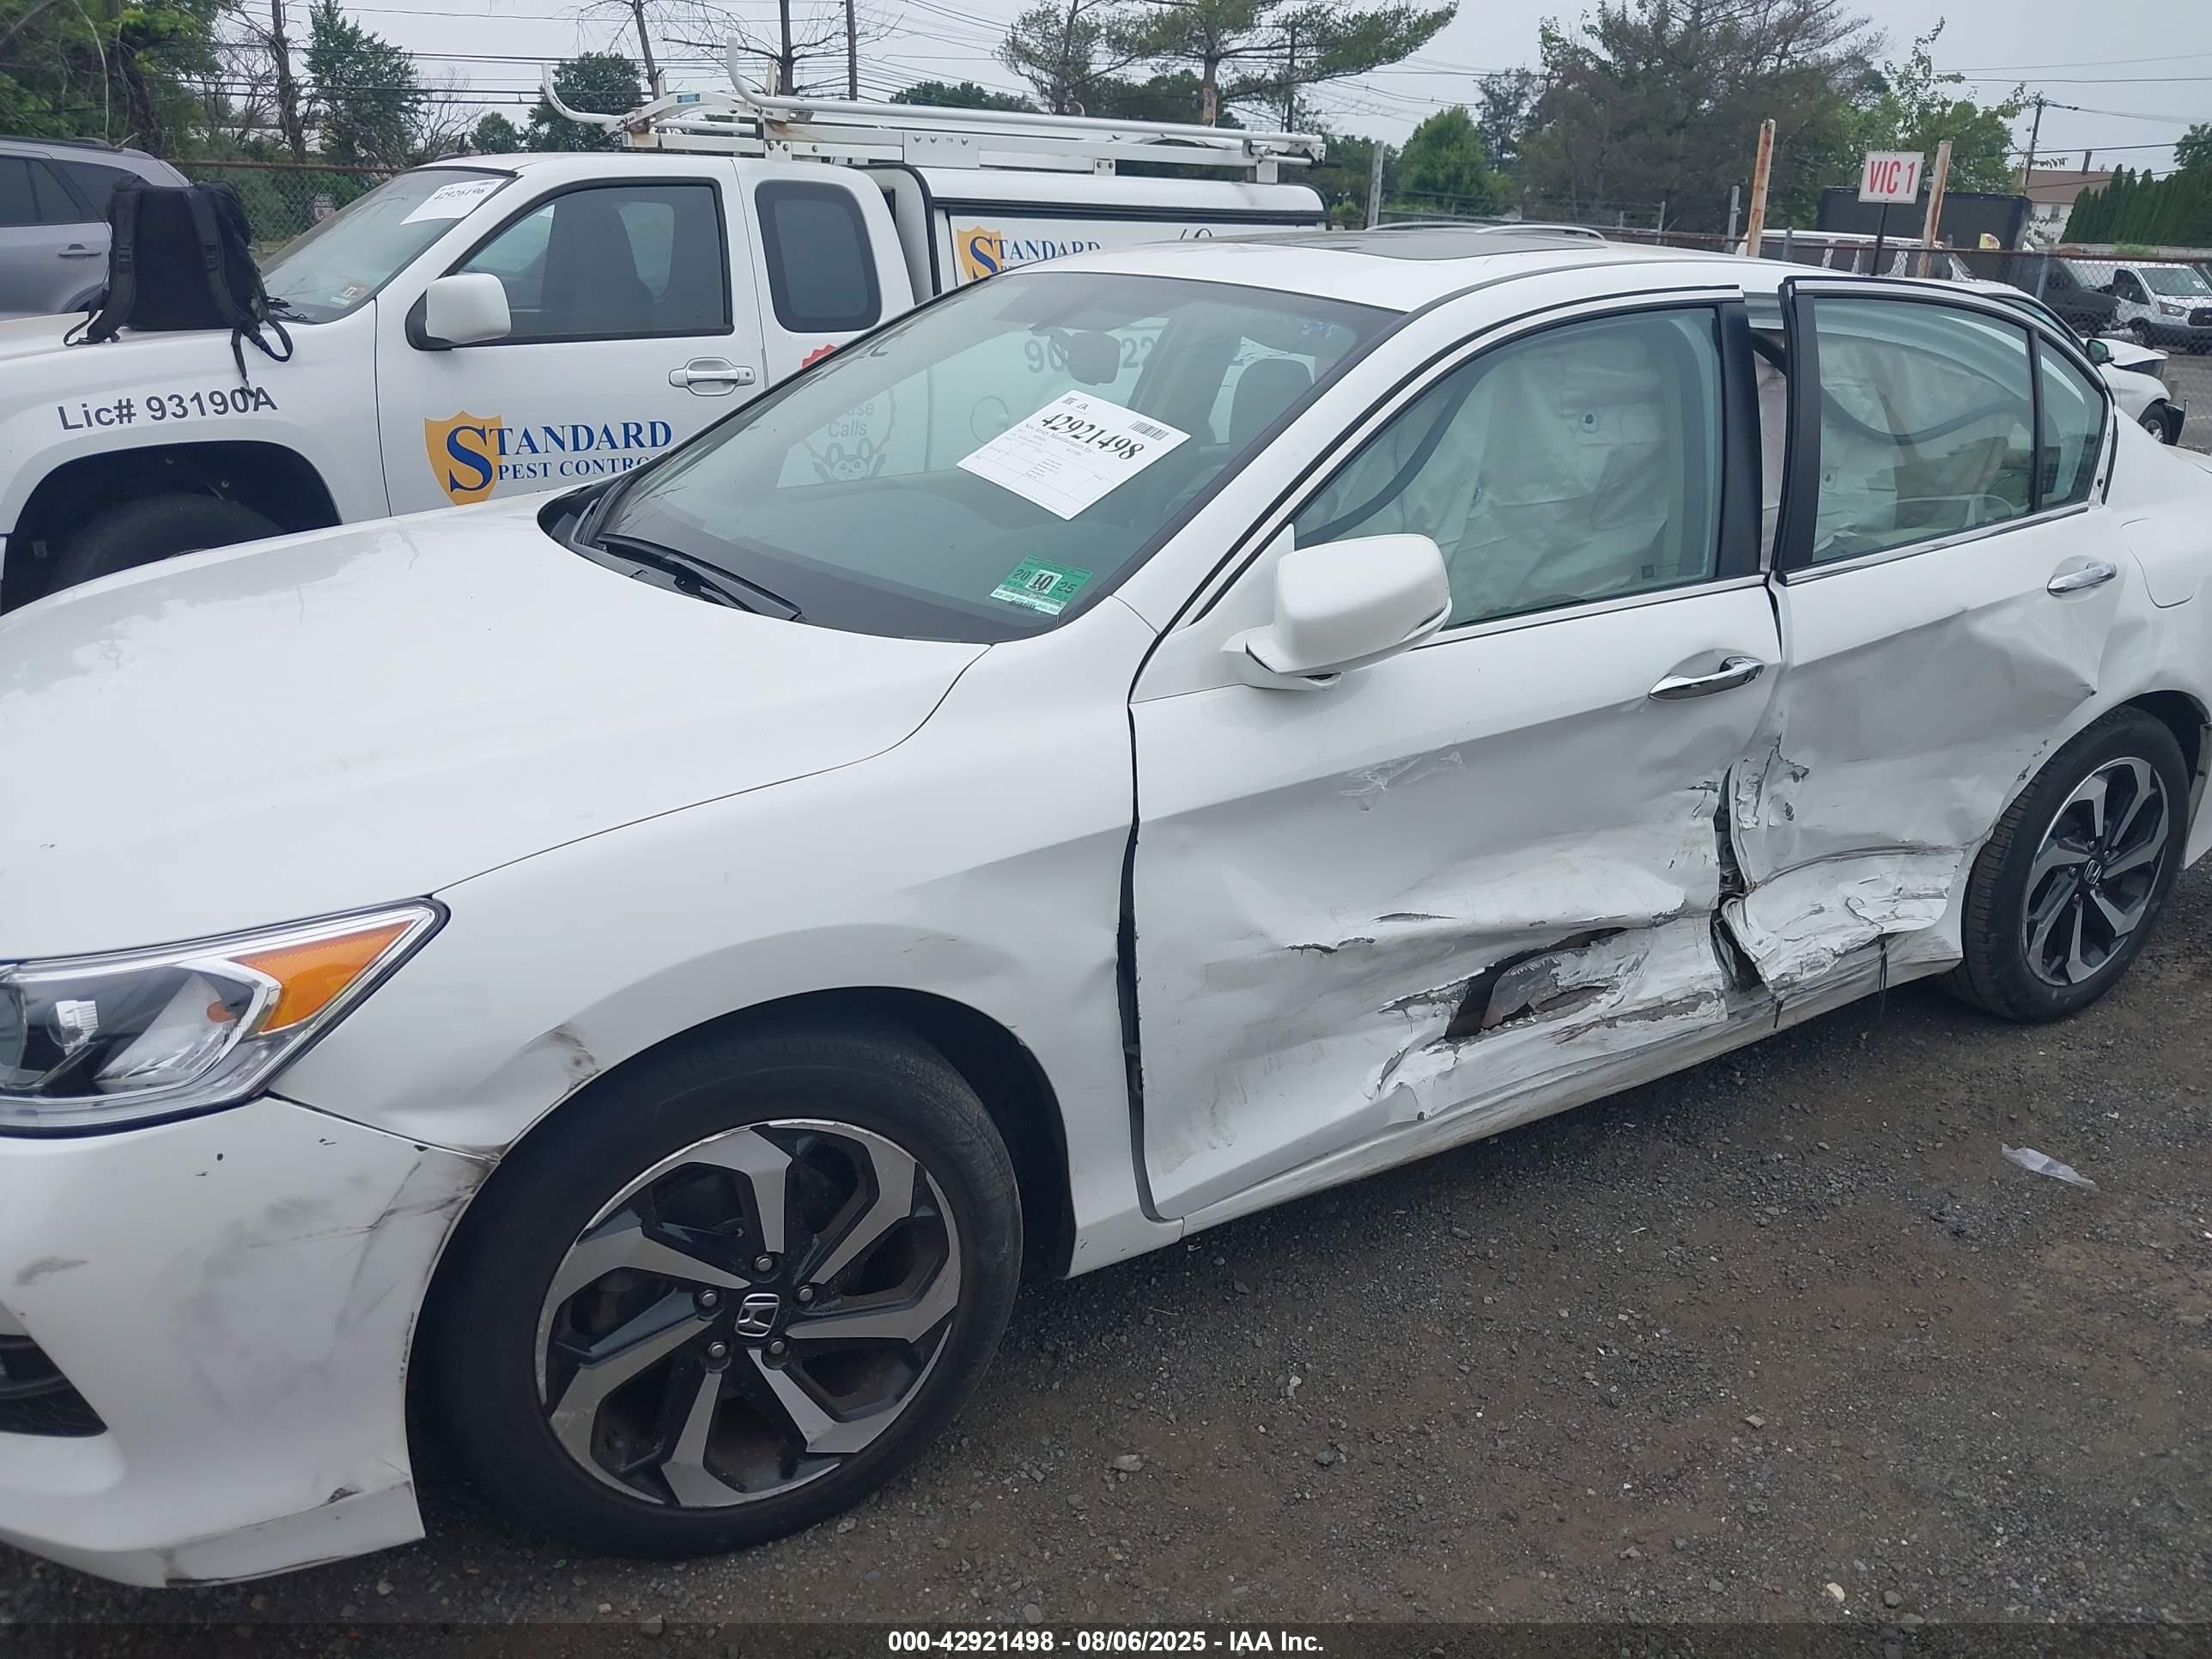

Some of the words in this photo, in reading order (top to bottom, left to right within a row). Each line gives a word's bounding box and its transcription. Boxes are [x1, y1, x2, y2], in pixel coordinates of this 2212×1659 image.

[1869, 161, 1901, 194] VIC
[1905, 161, 1916, 194] 1
[58, 398, 137, 430] Lic#
[145, 386, 278, 422] 93190A
[828, 419, 868, 438] Calls
[1041, 412, 1146, 460] 42921498
[447, 420, 673, 493] STANDARD
[498, 461, 552, 481] PEST
[559, 456, 650, 477] CONTR
[1012, 568, 1030, 581] 20
[1032, 573, 1054, 592] 10
[1057, 581, 1078, 593] 25
